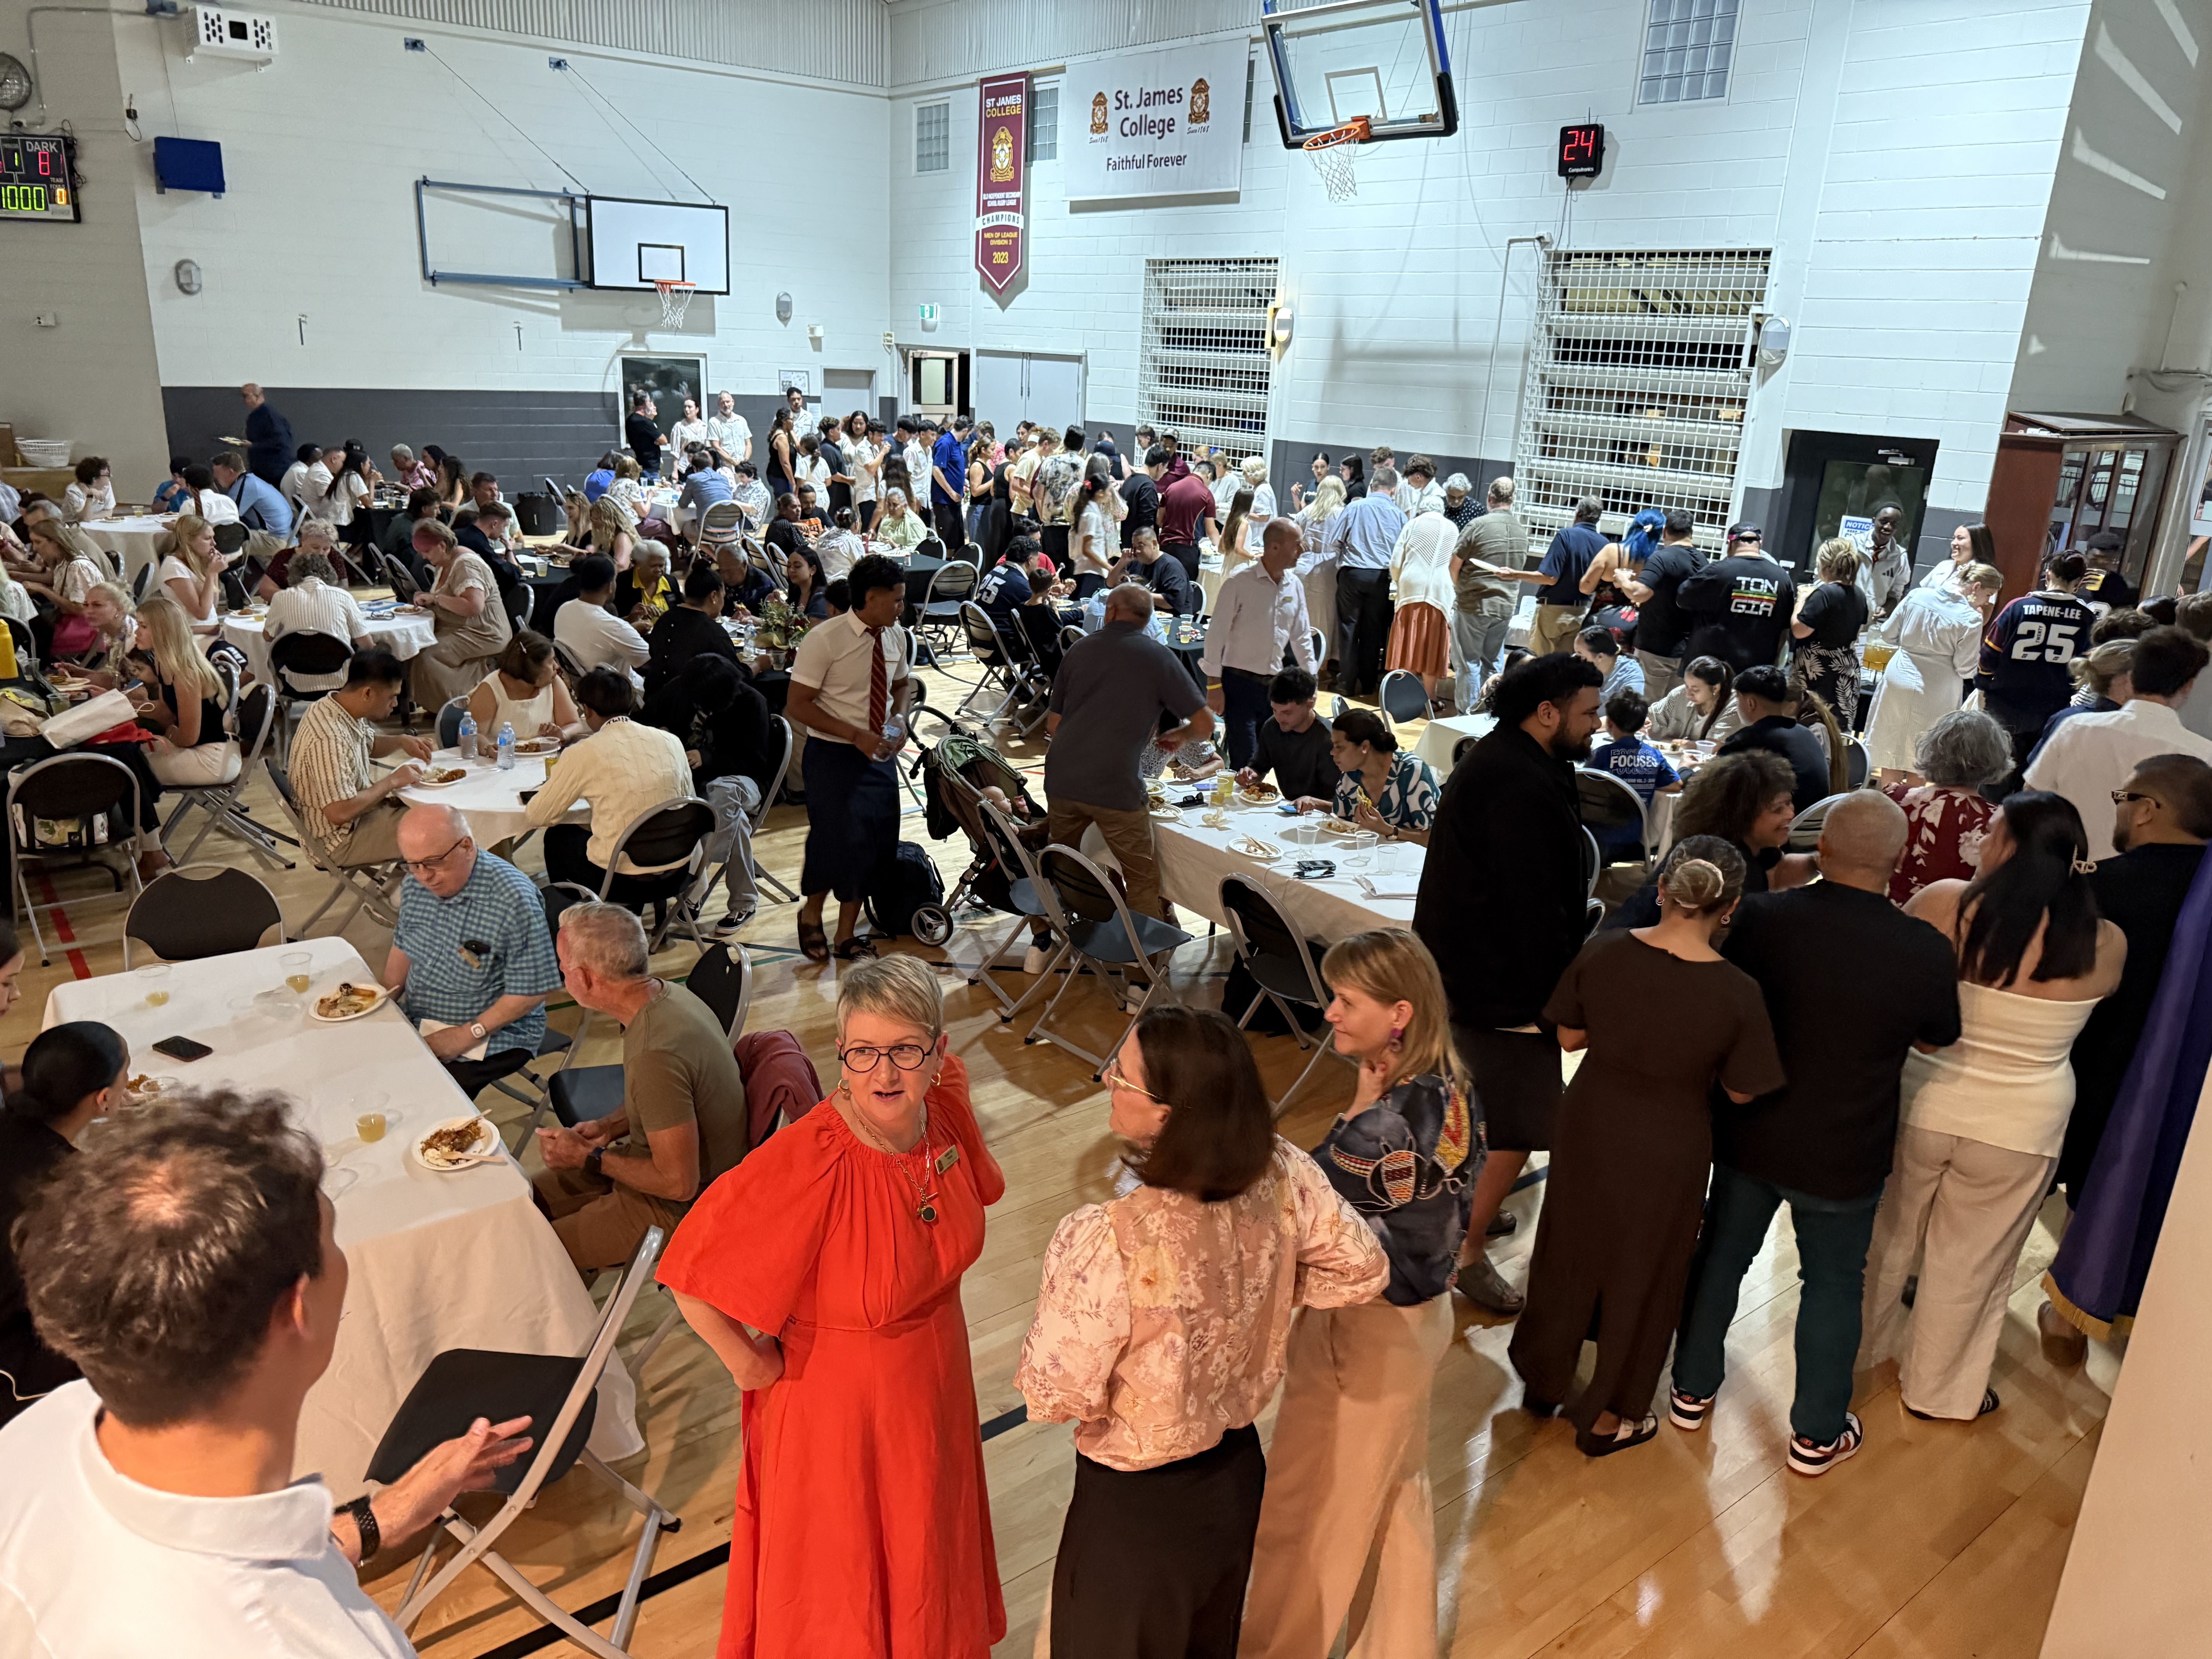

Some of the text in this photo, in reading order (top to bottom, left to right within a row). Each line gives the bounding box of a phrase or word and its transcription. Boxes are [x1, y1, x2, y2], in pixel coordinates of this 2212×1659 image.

[986, 94, 1022, 108] ST JAMES
[1115, 87, 1183, 110] St. James
[986, 105, 1022, 118] COLLEGE
[1120, 114, 1175, 140] College
[26, 141, 58, 153] DARK
[1563, 130, 1595, 161] 24
[1106, 154, 1187, 172] Faithful Forever
[982, 214, 1020, 225] CHAMPIONS
[993, 251, 1009, 264] 2023
[1736, 576, 1779, 594] TON
[1730, 598, 1774, 617] GIA
[2023, 605, 2082, 620] TAPENE-LEE
[2011, 621, 2081, 664] 25
[2035, 625, 2044, 643] TWENTY
[1609, 755, 1659, 769] FOCUSED
